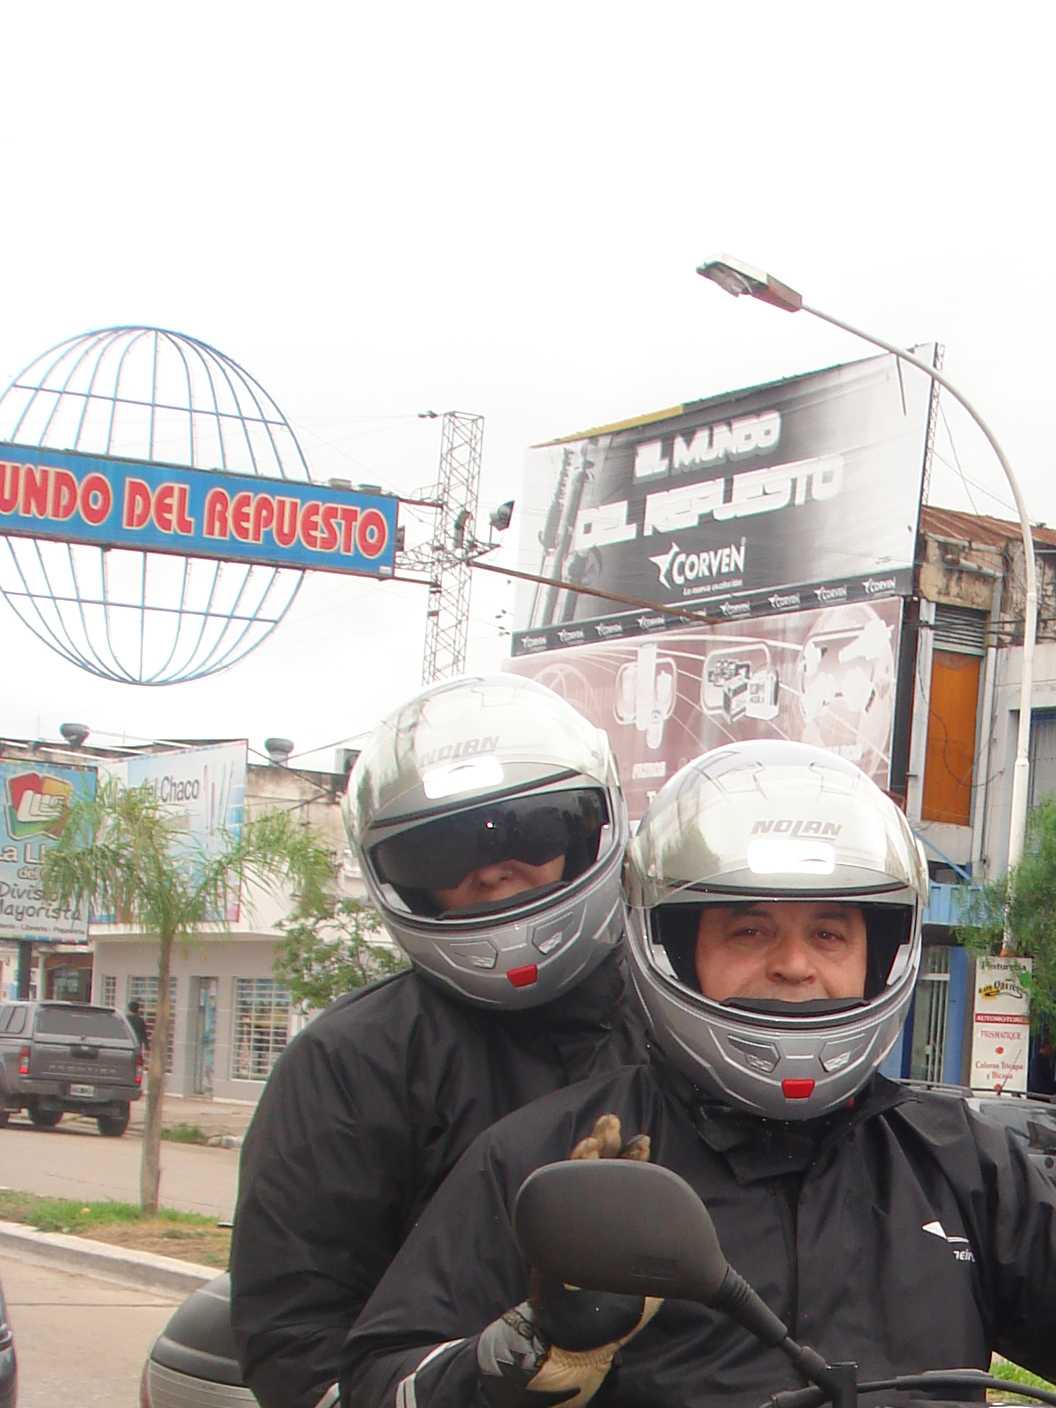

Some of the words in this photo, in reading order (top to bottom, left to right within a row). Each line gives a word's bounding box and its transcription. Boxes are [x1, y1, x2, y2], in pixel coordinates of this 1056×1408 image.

[672, 411, 781, 472] MUNDO
[122, 476, 193, 536] DEL
[203, 487, 389, 559] REPUESTO
[672, 543, 746, 584] CORVEN
[160, 776, 200, 803] Chaco
[751, 819, 842, 840] NOLAN
